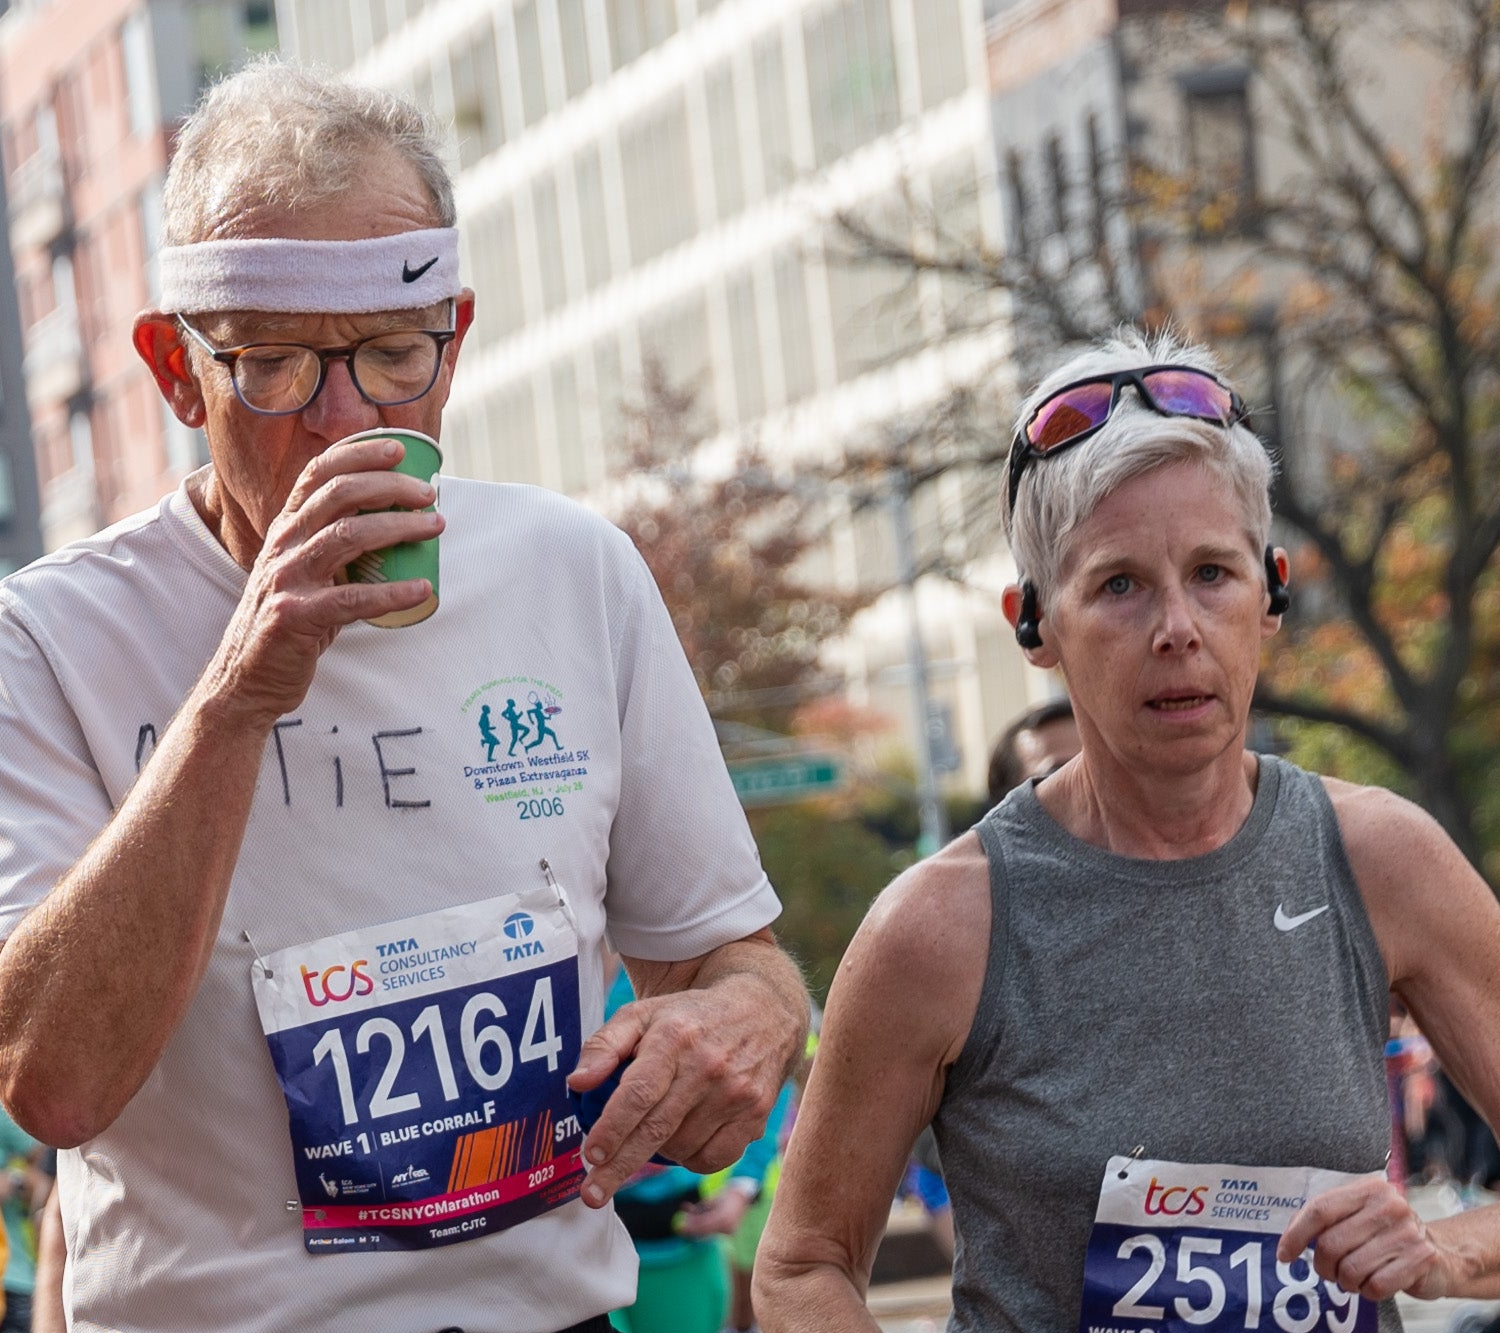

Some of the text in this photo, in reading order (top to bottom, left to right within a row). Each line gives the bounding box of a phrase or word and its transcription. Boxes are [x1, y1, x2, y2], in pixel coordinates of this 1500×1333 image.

[135, 719, 431, 808] TiE
[464, 750, 590, 778] Downtown Westfield 5K
[474, 767, 588, 790] & Pizza Extravaganza
[516, 797, 565, 820] 2006
[376, 938, 419, 958] TATA
[379, 940, 478, 975] CONSULTANCY
[502, 940, 545, 963] TATA
[300, 959, 374, 1008] tcs
[382, 965, 446, 992] SERVICES
[312, 976, 564, 1126] 12164
[304, 1100, 497, 1160] WAVE 1 BLUE CORRAL F
[528, 1164, 555, 1188] 2023
[1219, 1179, 1259, 1192] TATA
[357, 1189, 500, 1221] #TCSNYCMarathon
[1144, 1176, 1209, 1216] tcs
[1215, 1192, 1306, 1209] CONSULTANCY
[1211, 1207, 1271, 1221] SERVICES
[429, 1217, 487, 1240] Team: CJTC
